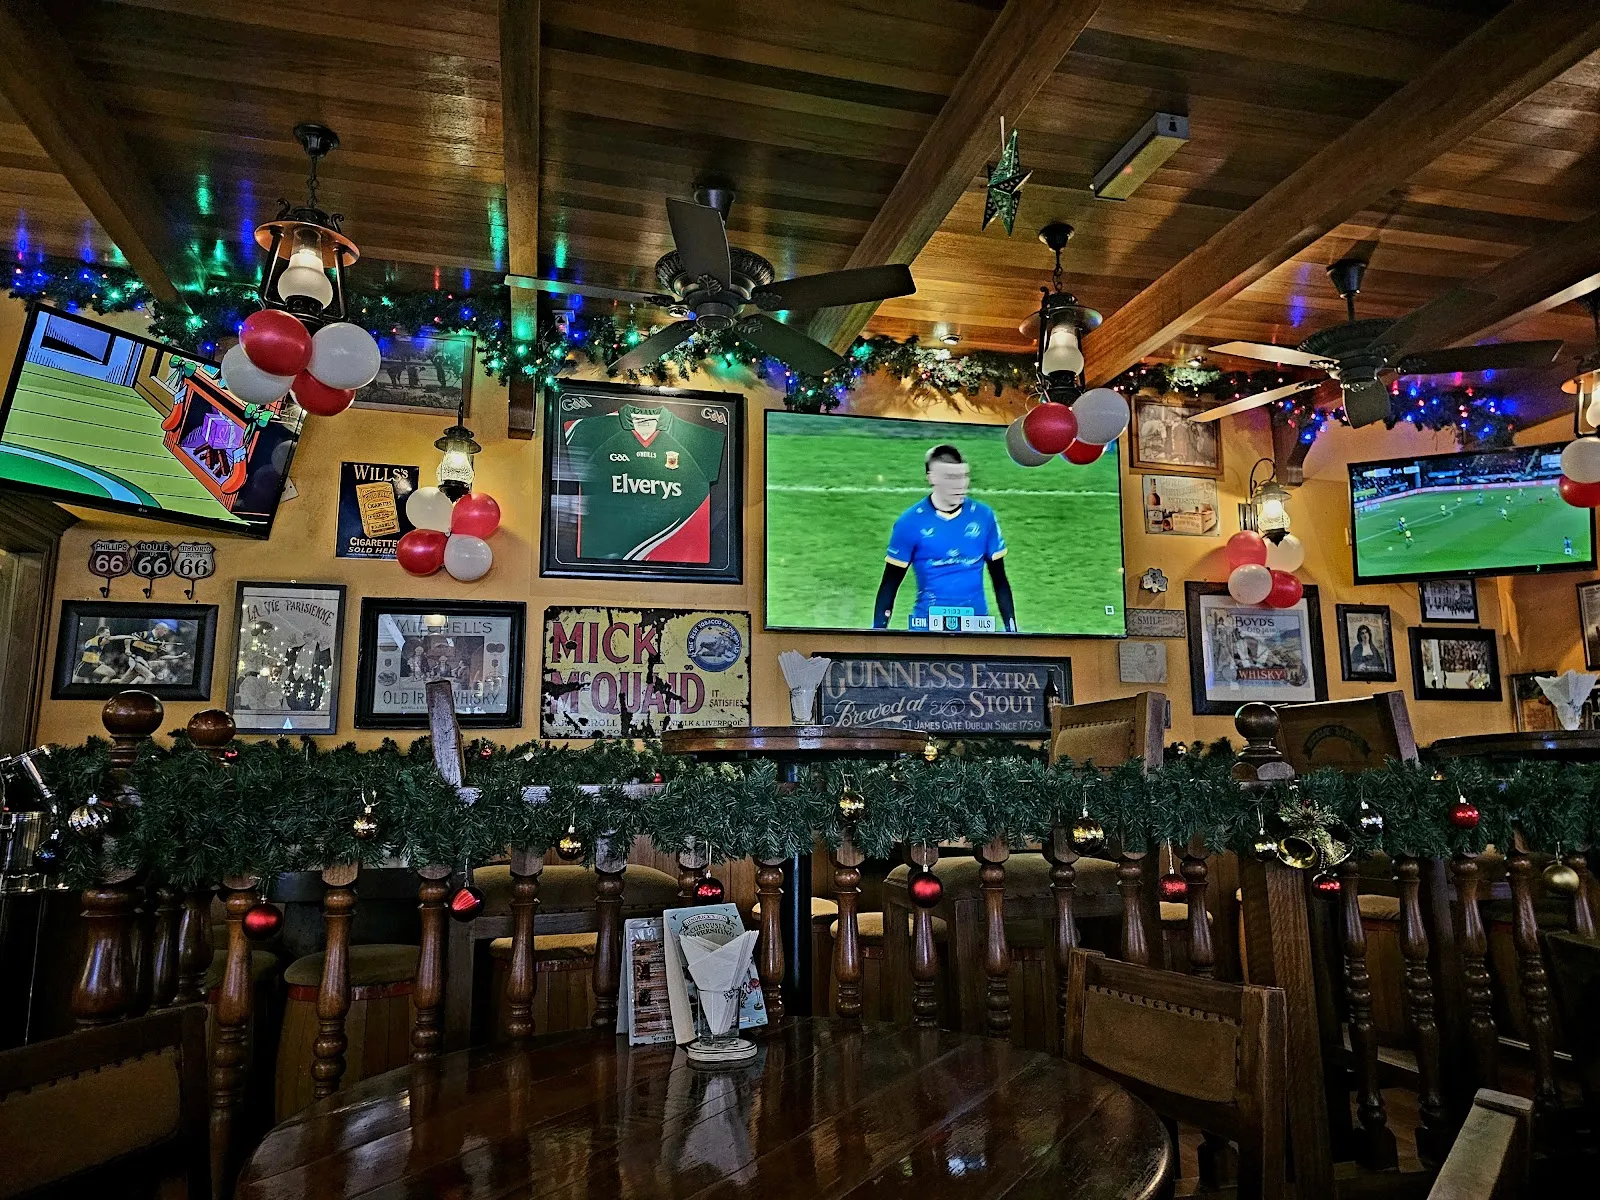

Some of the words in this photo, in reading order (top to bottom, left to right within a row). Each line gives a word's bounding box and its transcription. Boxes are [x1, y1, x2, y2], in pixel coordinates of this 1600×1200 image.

[611, 473, 683, 500] Elverys
[95, 543, 128, 551] PHILLIPS
[140, 543, 168, 551] ROUTE
[348, 546, 373, 554] SOLD
[349, 537, 398, 548] CIGARETTE
[95, 554, 124, 573] 66
[137, 556, 168, 575] 66
[180, 558, 208, 576] 66
[264, 600, 280, 615] VIE
[551, 621, 664, 665] MICK
[825, 660, 966, 699] GUINNESS
[970, 662, 1041, 693] EXTRA
[1239, 670, 1284, 680] WHISKY
[383, 690, 409, 705] OLD
[711, 689, 720, 699] IT
[834, 694, 907, 728] Brewed
[906, 693, 929, 712] at
[969, 690, 1036, 718] STOUT
[915, 720, 940, 731] JAMES
[1018, 720, 1042, 732] 1759
